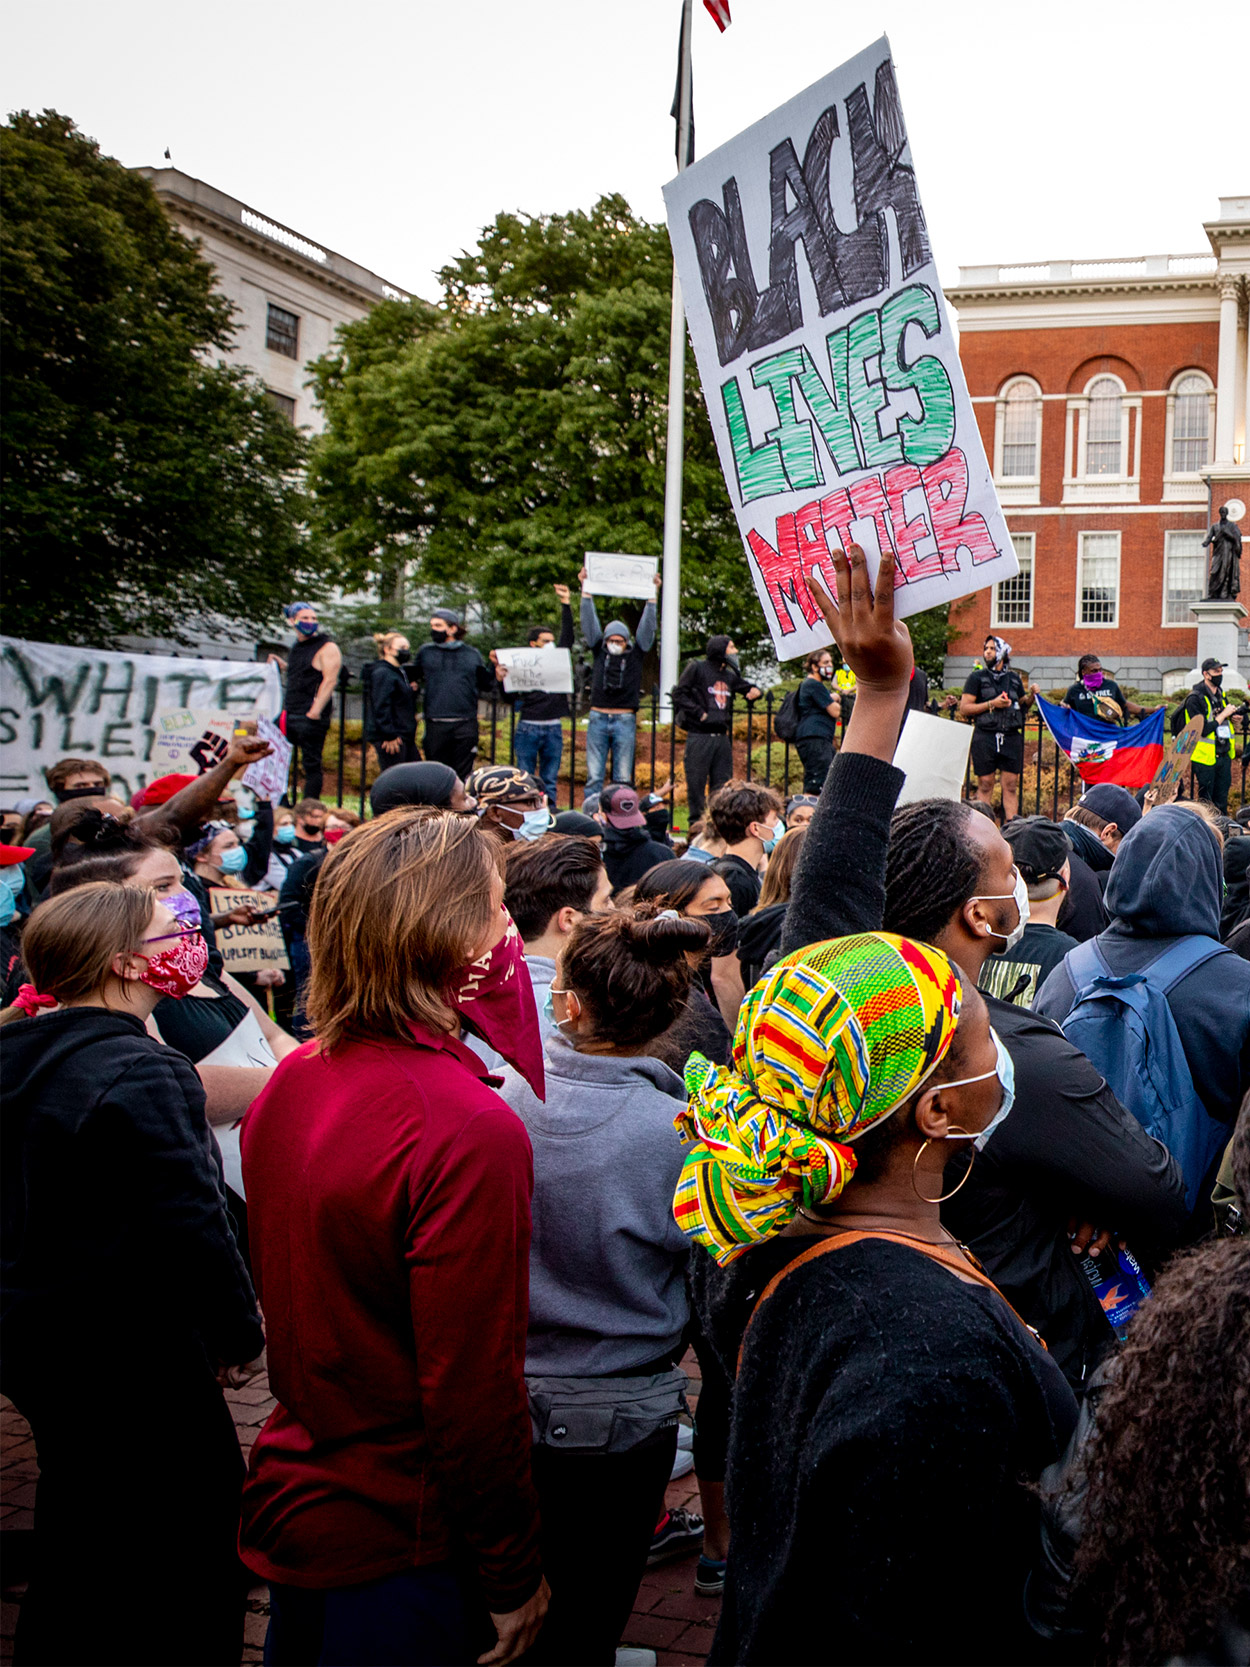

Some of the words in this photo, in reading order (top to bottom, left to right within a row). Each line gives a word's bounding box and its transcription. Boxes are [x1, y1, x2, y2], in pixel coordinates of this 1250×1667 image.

[688, 59, 933, 367] BLACK
[719, 282, 956, 505] LIVES
[746, 446, 1003, 637] MATTER
[4, 645, 266, 726] WHITE
[215, 895, 259, 913] LISTEN
[1123, 1248, 1141, 1275] wate
